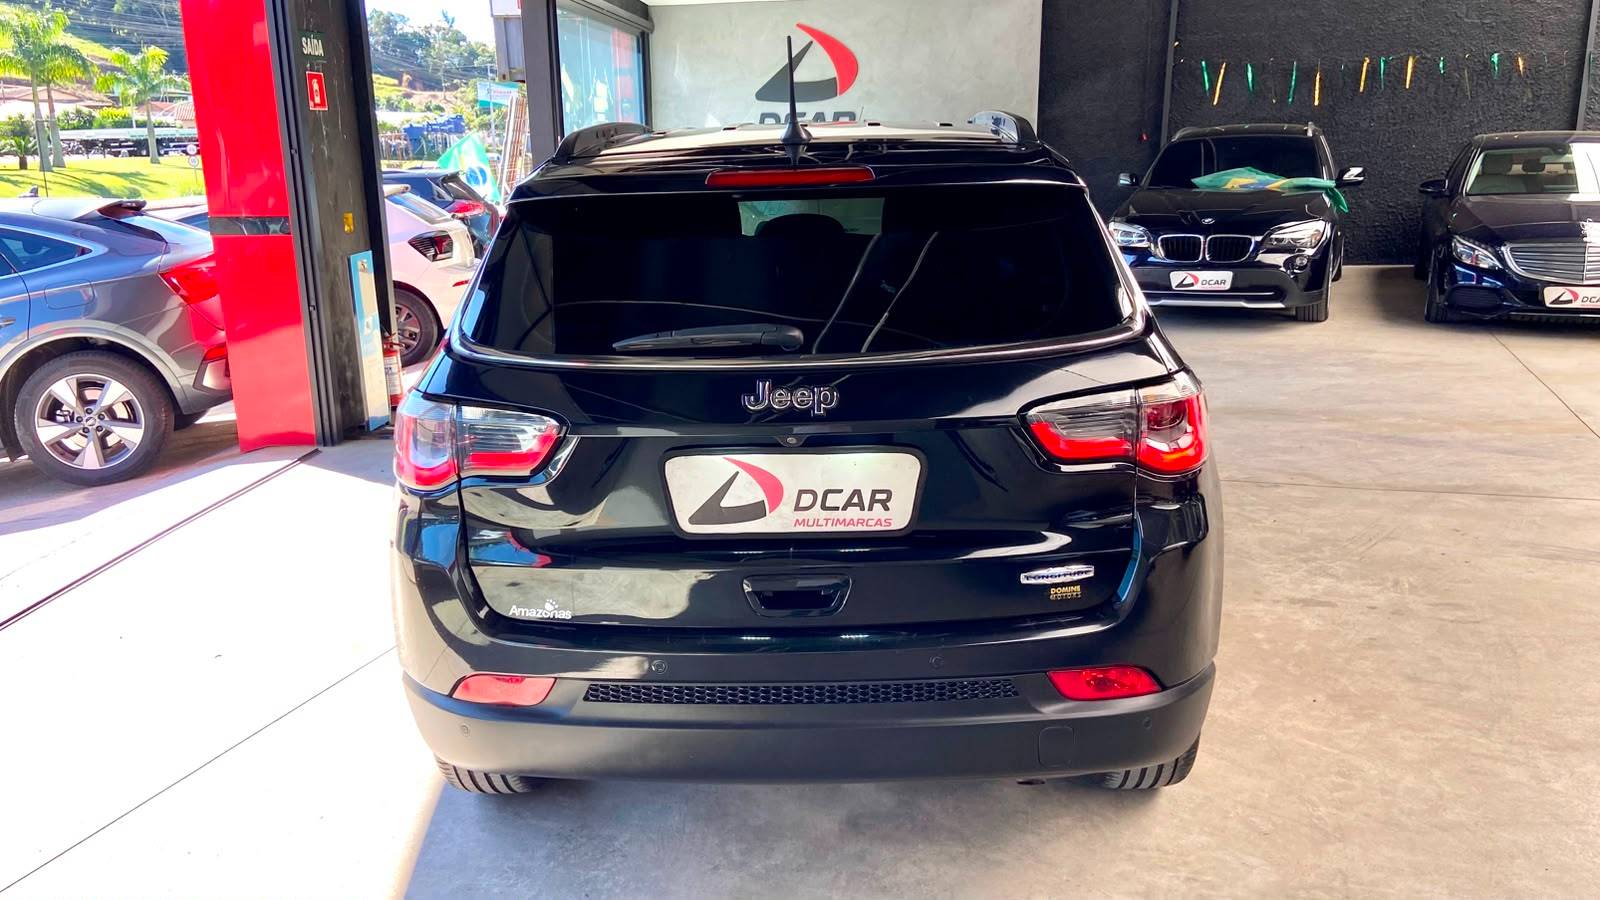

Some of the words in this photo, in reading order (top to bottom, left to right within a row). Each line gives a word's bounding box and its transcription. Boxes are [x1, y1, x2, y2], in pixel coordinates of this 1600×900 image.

[301, 34, 324, 57] SAÍDA
[741, 379, 839, 416] Jeep
[793, 488, 893, 513] DCAR
[793, 517, 893, 528] MULTIMARCAS
[1050, 585, 1081, 594] DOMINE
[508, 604, 572, 620] Amazonas
